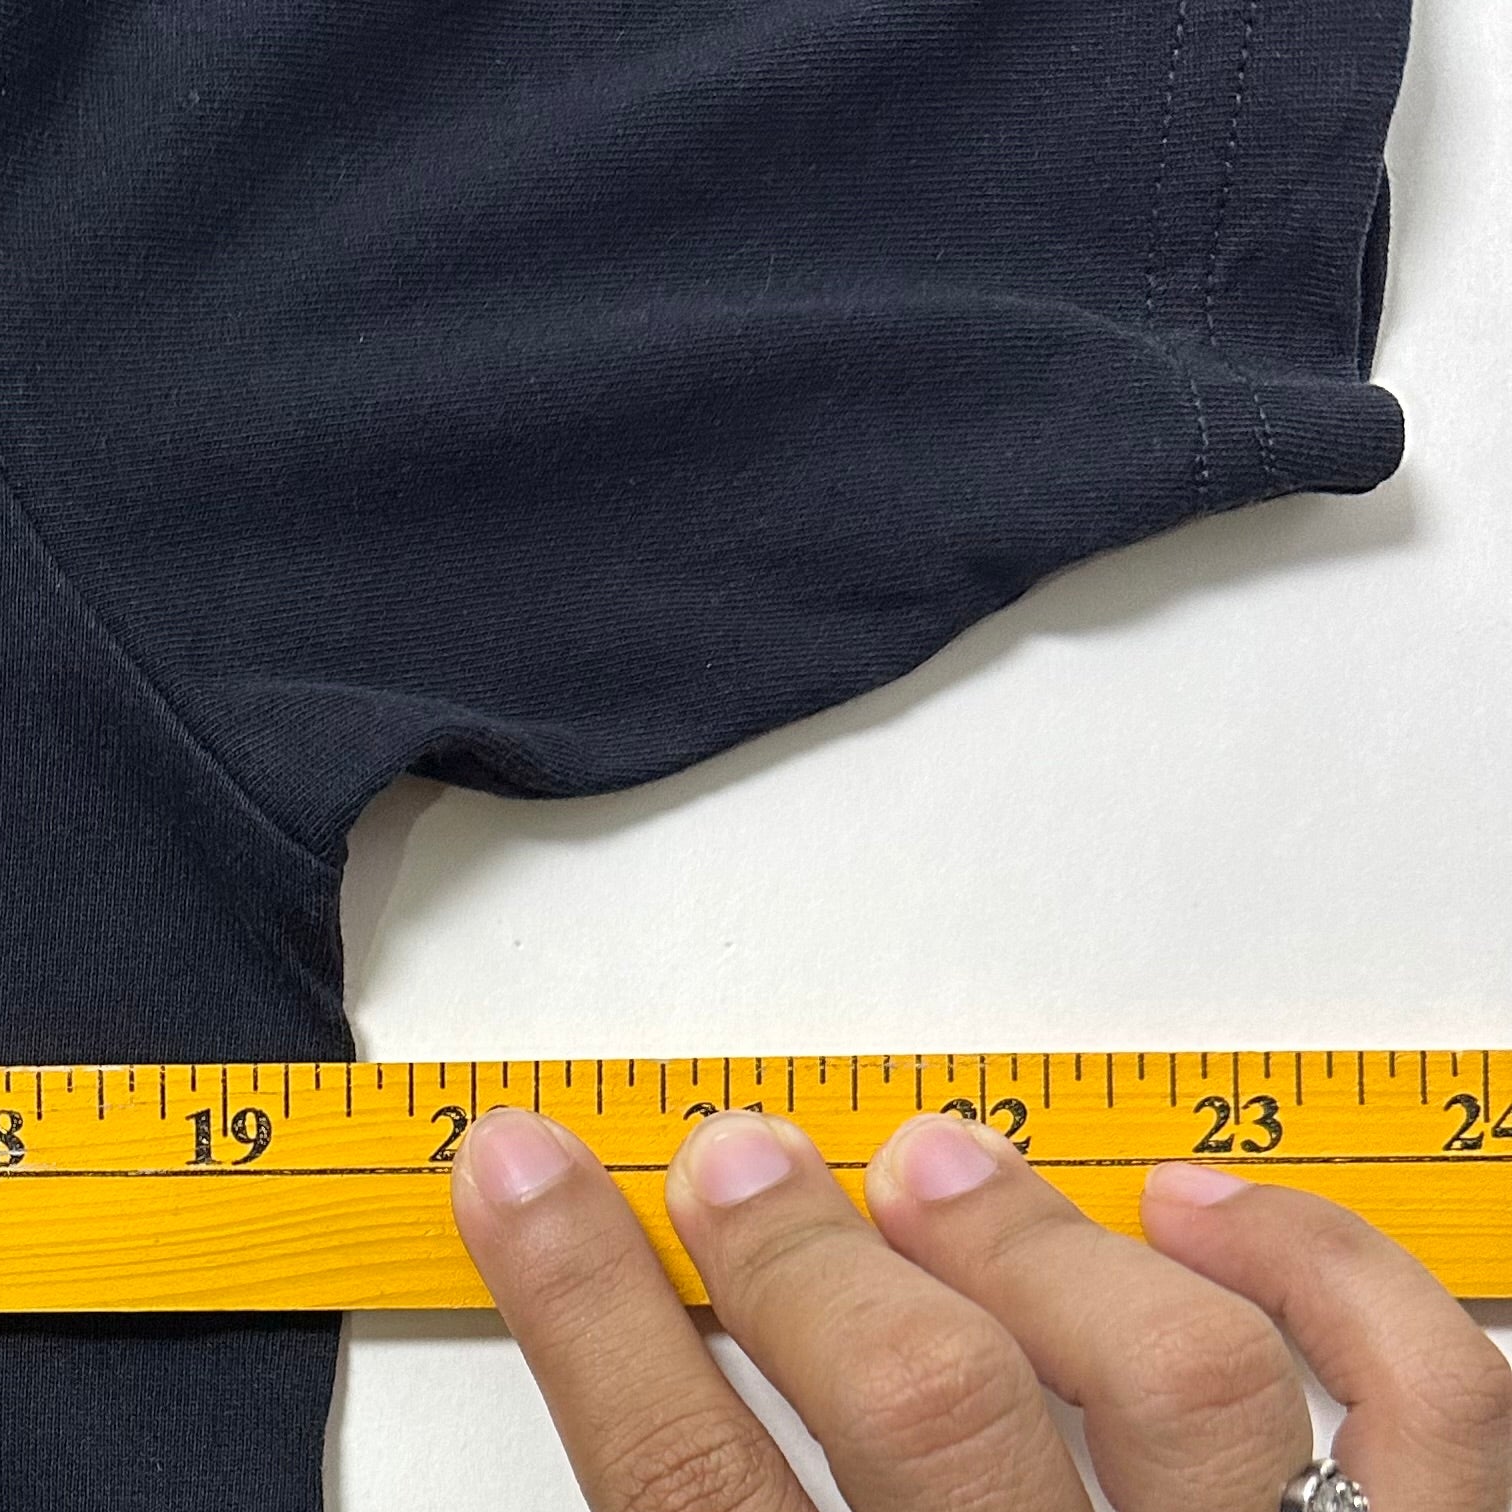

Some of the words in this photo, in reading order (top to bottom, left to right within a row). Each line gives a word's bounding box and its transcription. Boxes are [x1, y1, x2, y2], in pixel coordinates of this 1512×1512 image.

[185, 1107, 272, 1165] 19
[429, 1105, 509, 1162] 2
[1192, 1095, 1283, 1153] 23
